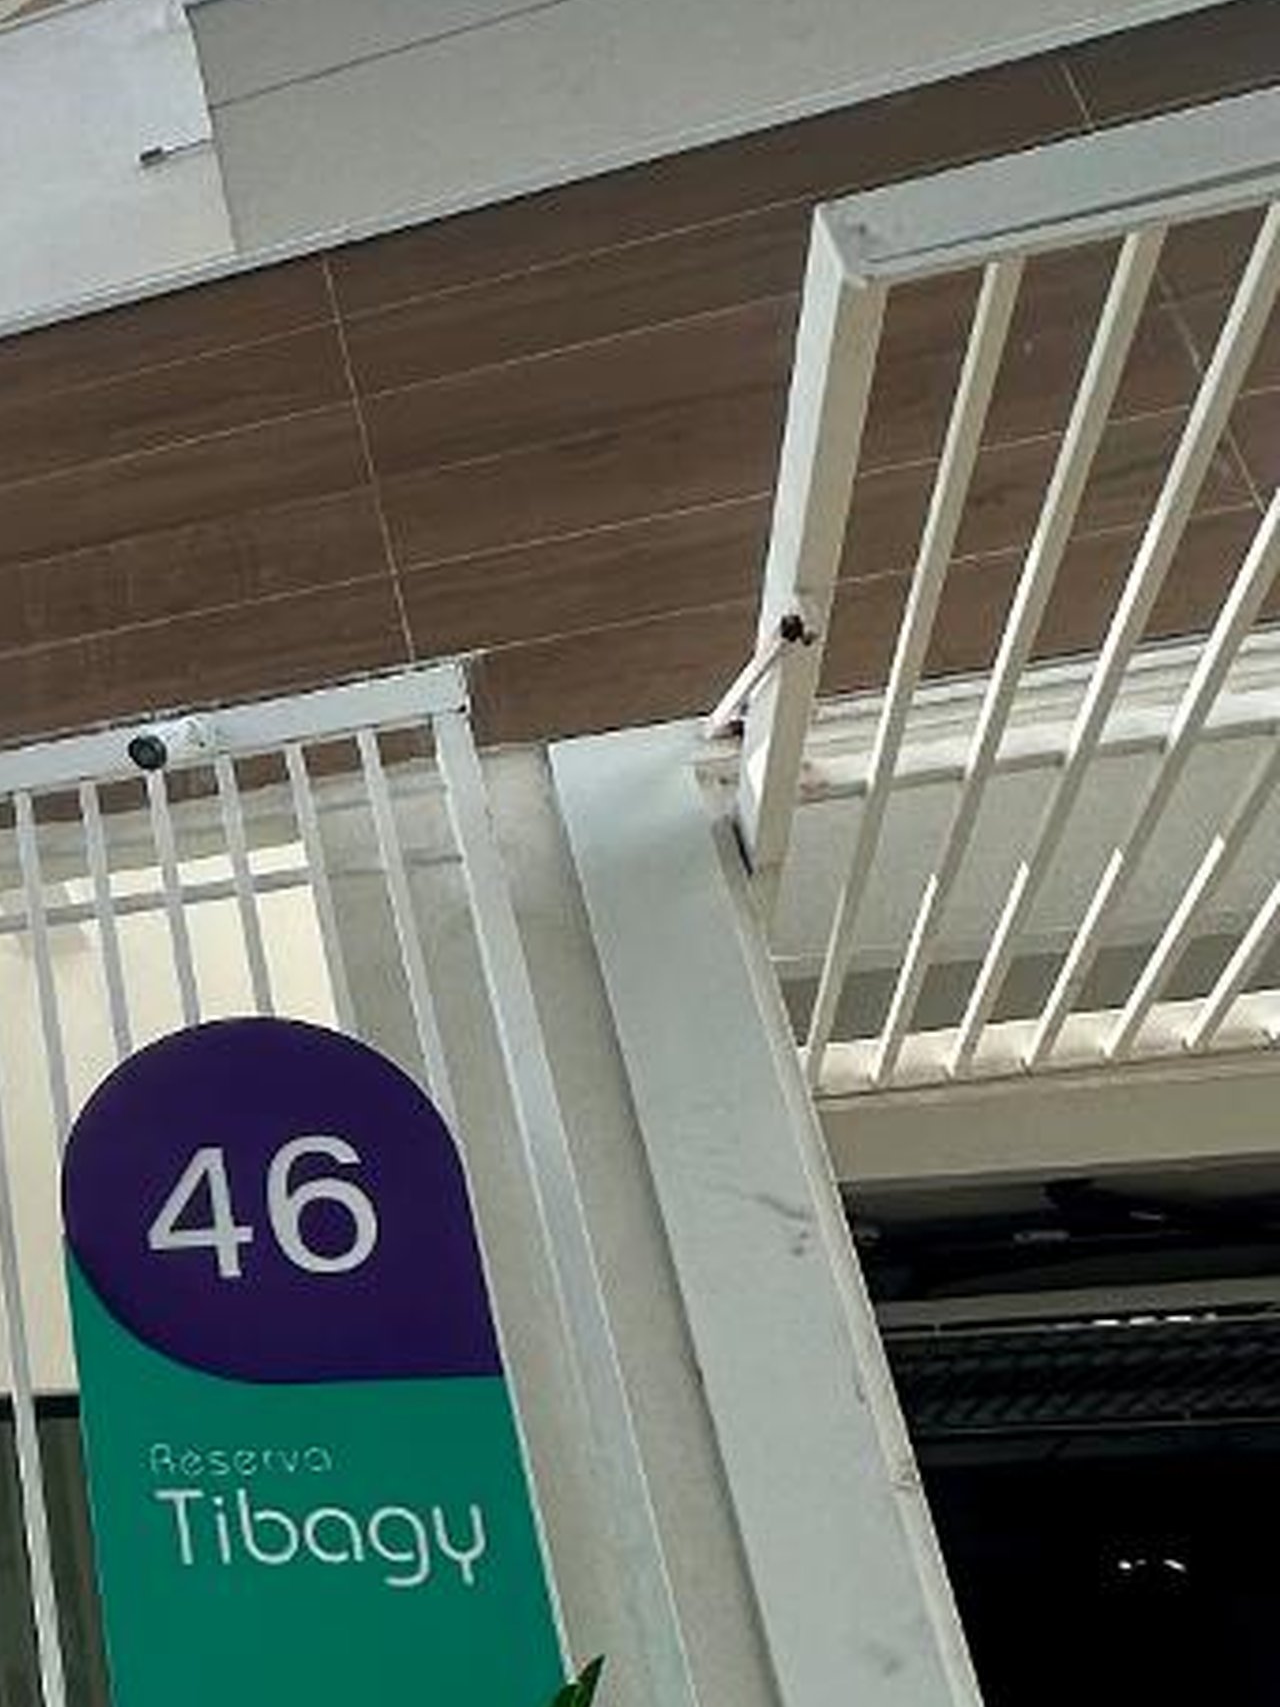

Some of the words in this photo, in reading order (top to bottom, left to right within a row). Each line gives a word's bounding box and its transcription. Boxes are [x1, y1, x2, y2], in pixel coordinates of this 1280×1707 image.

[147, 1135, 379, 1280] 46
[149, 1442, 334, 1477] Reserva
[154, 1489, 488, 1587] Tibagy
